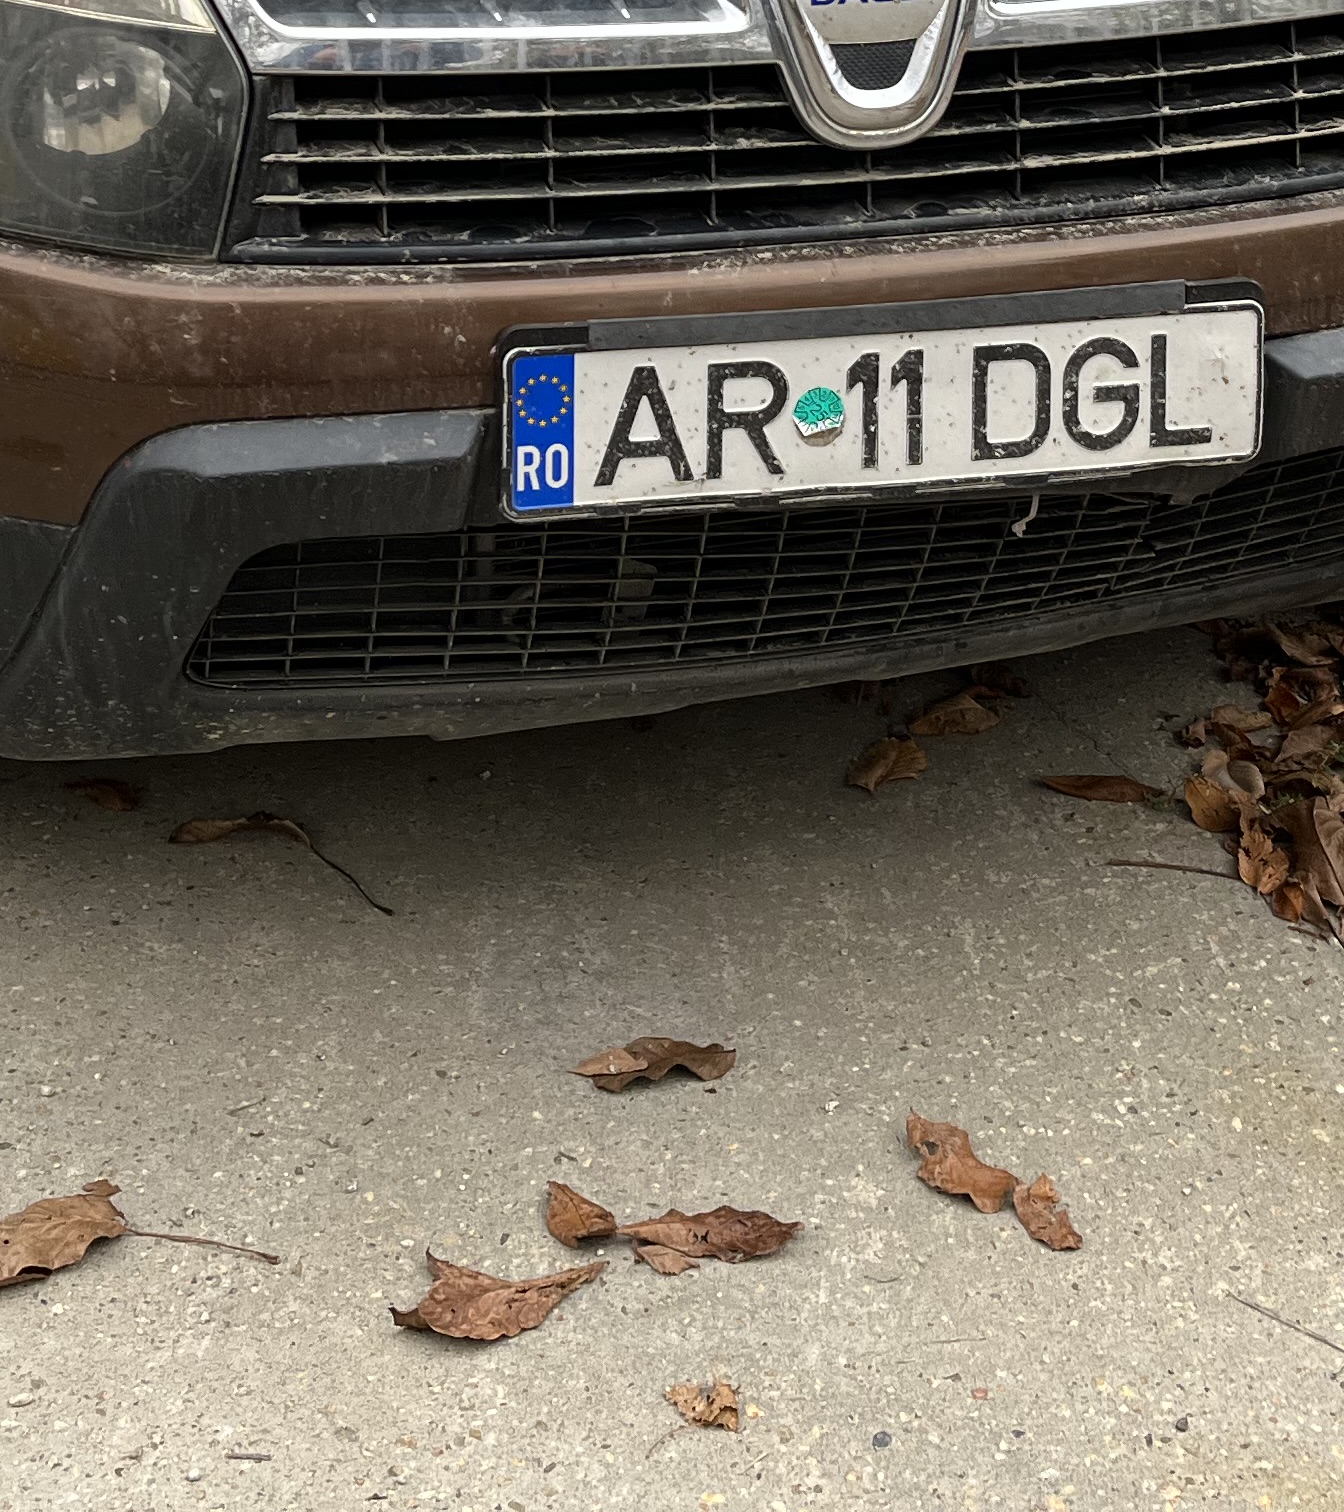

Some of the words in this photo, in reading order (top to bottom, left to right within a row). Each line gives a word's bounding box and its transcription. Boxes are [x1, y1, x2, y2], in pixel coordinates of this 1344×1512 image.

[594, 360, 789, 487] AR
[846, 348, 924, 469] 11
[971, 333, 1213, 462] DGL
[516, 443, 568, 492] RO
